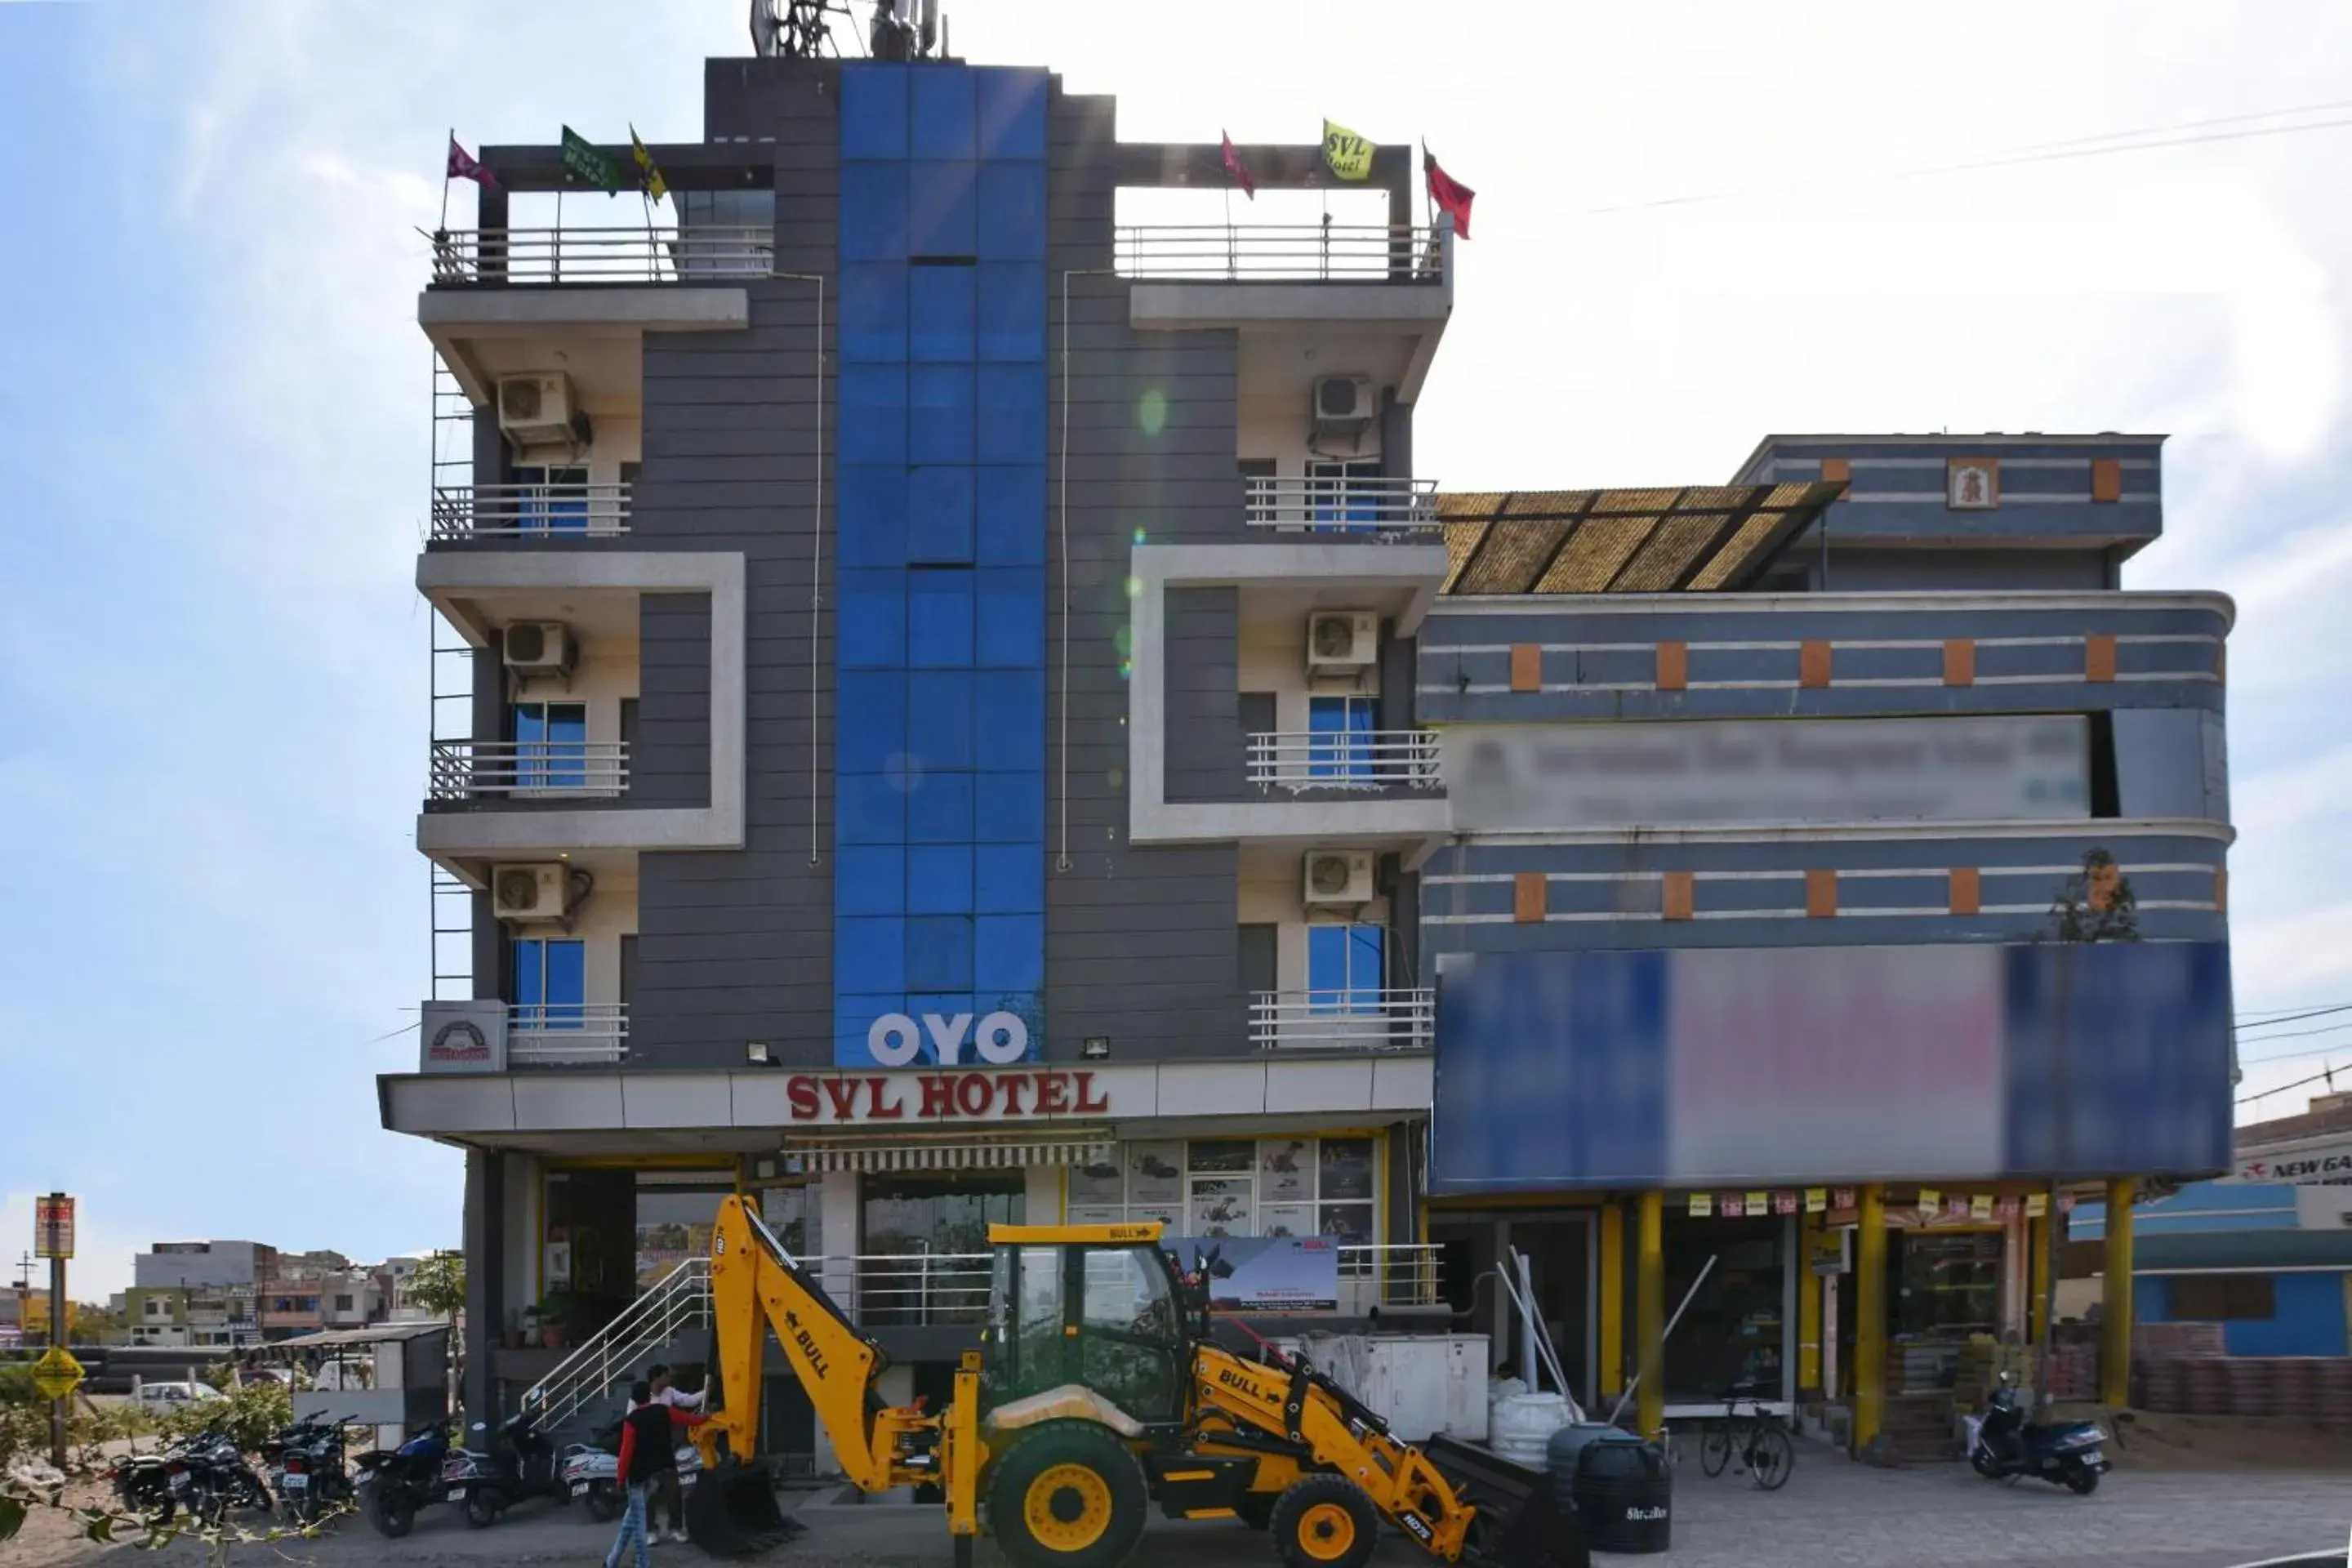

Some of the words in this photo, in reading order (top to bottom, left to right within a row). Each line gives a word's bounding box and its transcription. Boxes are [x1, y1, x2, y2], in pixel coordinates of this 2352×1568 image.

[1329, 132, 1368, 157] SVL
[867, 1012, 1028, 1067] OYO
[786, 1076, 902, 1120] SVL
[916, 1071, 1108, 1118] HOTEL
[2272, 1160, 2321, 1178] NEW
[1109, 1227, 1135, 1239] BULL
[796, 1330, 829, 1380] BULL
[1218, 1368, 1260, 1397] BULL
